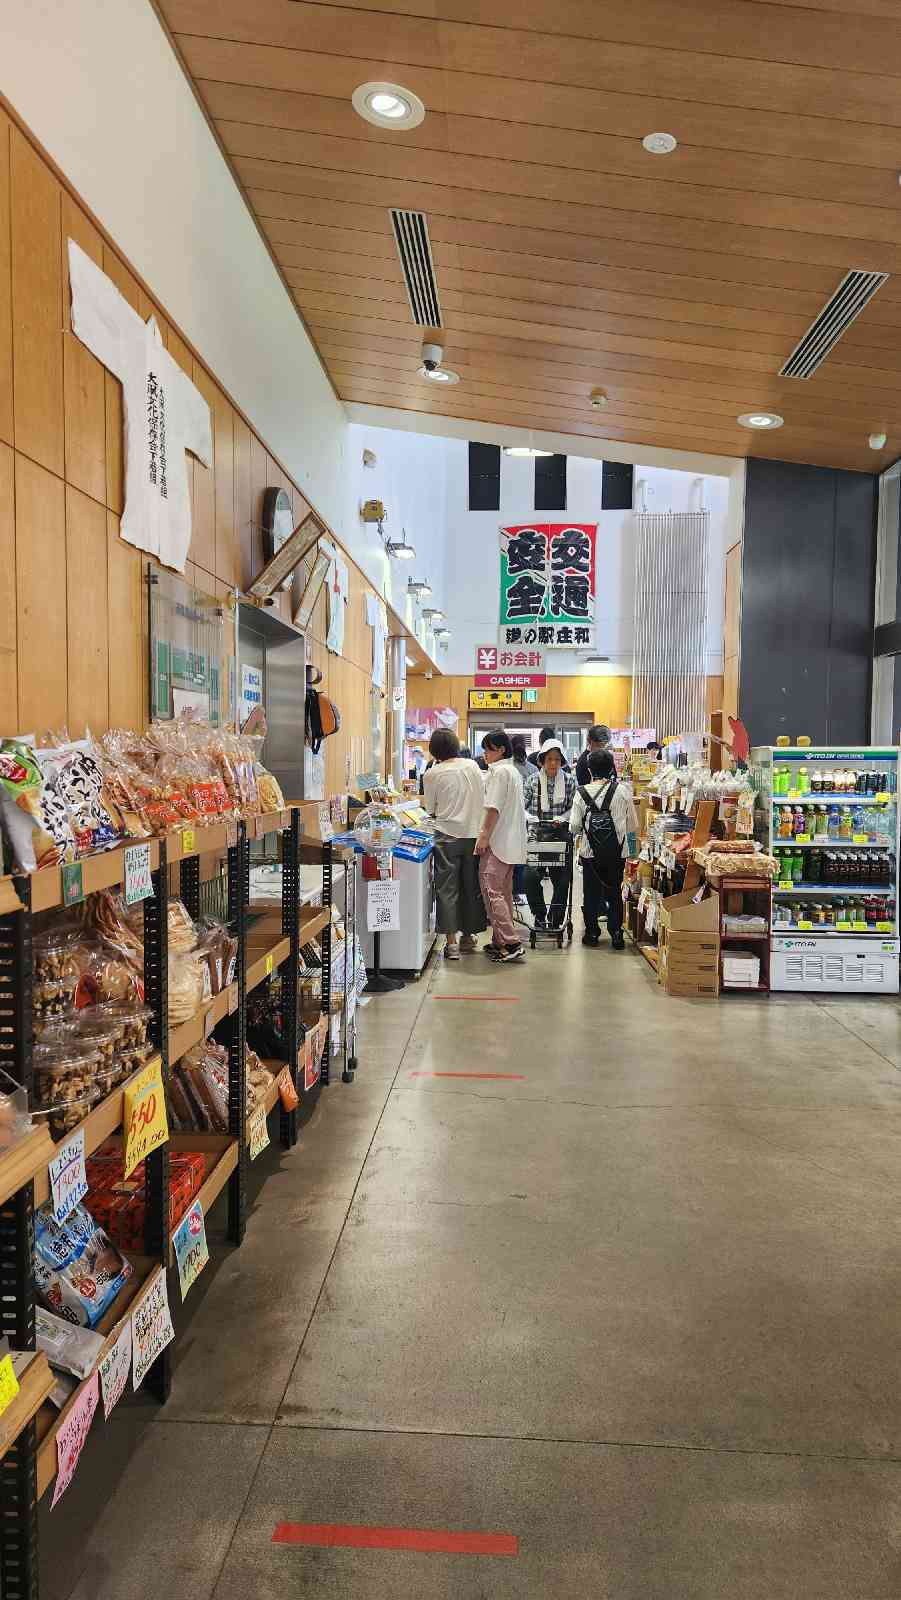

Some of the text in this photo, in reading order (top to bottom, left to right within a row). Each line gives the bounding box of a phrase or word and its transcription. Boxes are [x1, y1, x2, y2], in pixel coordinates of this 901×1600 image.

[505, 626, 590, 644] 道の駅庄和
[500, 651, 542, 667] お会計
